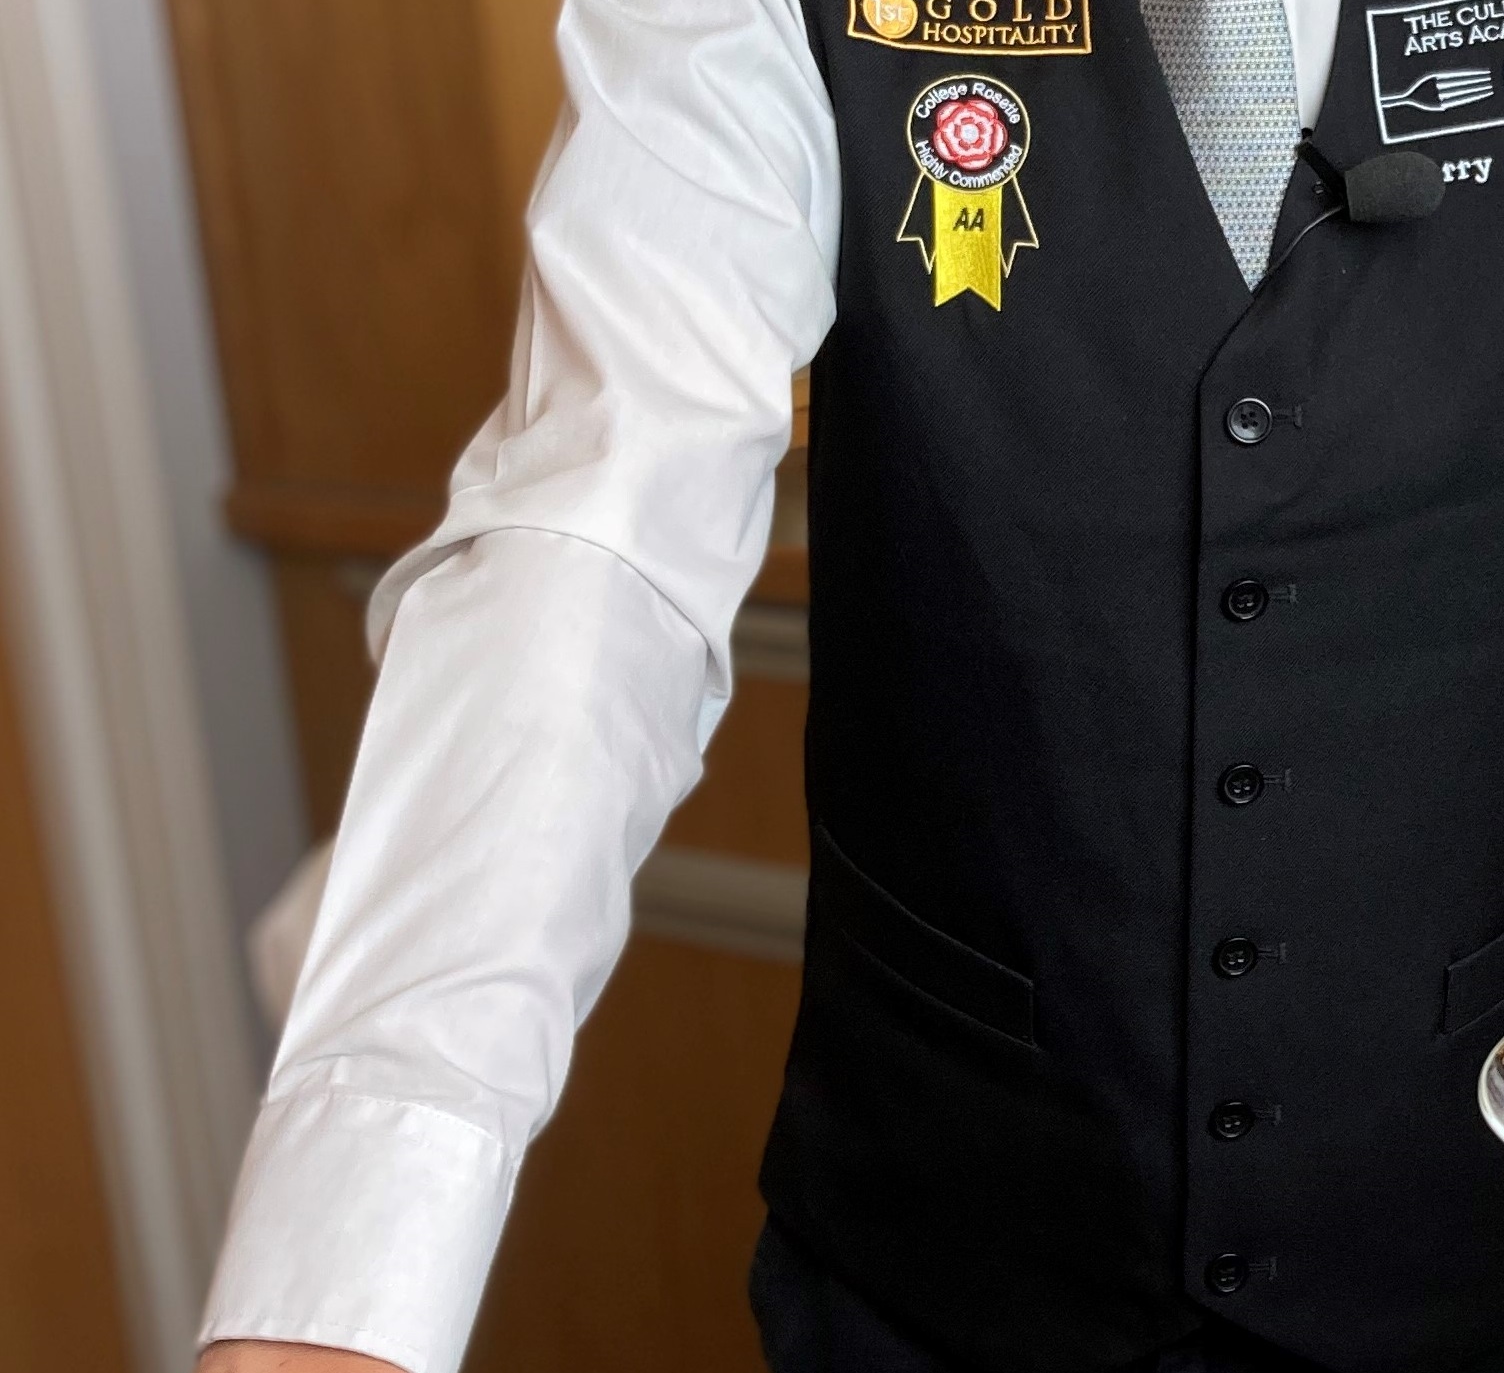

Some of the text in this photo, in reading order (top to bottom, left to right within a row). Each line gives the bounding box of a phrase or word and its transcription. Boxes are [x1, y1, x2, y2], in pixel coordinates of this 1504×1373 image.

[923, 21, 1078, 46] HOSPITALITY
[1403, 10, 1453, 35] THE
[1404, 30, 1463, 56] ARTS
[915, 82, 1021, 124] College Rosette
[915, 139, 1023, 189] Highly Commended
[1441, 155, 1494, 184] rry
[952, 207, 985, 232] AA
